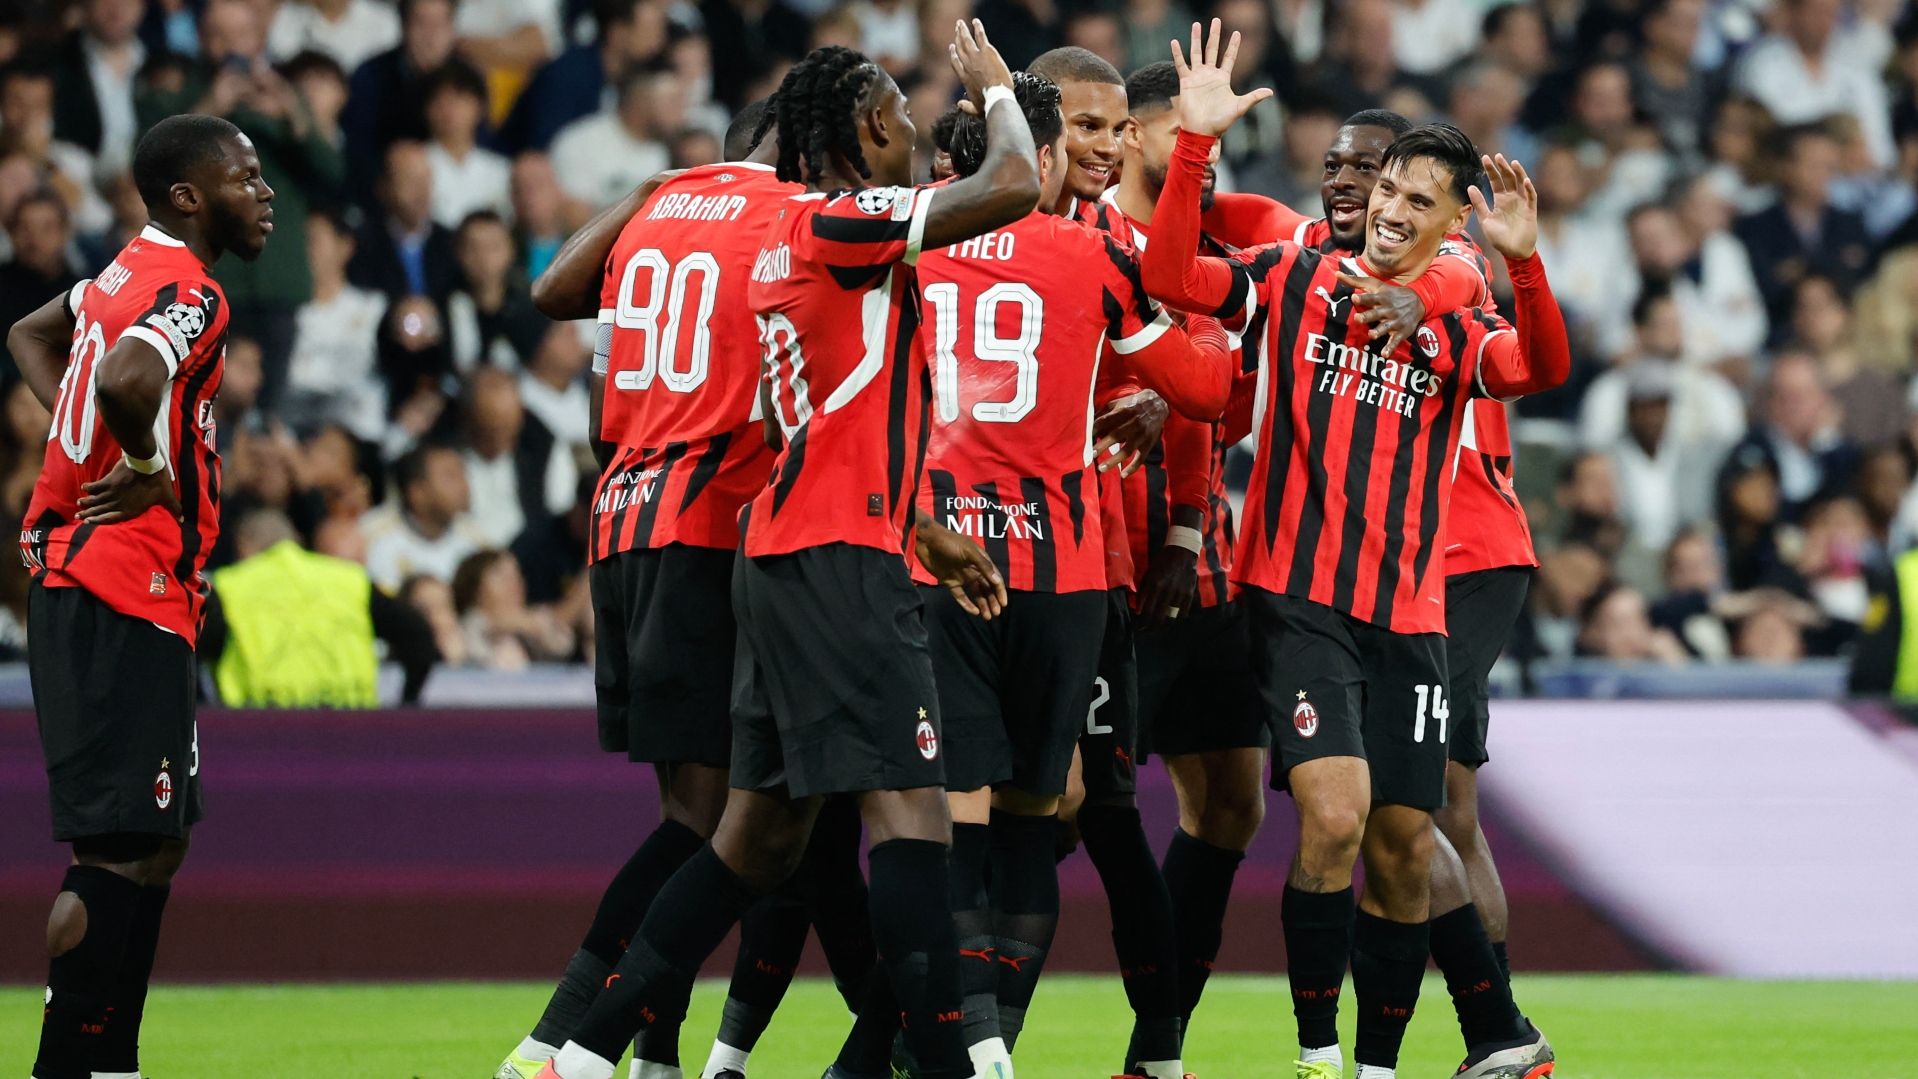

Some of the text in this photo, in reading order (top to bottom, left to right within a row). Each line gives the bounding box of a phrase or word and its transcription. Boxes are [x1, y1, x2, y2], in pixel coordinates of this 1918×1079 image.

[646, 194, 747, 221] ABRAHAM
[614, 248, 721, 394] 90
[923, 282, 1044, 423] 19
[1304, 331, 1442, 397] Emirates
[1318, 369, 1416, 419] FLY BETTER
[595, 481, 656, 514] MILAN
[946, 496, 1040, 517] FONDAIONE
[946, 513, 1044, 541] MILAN
[1413, 684, 1450, 744] 14
